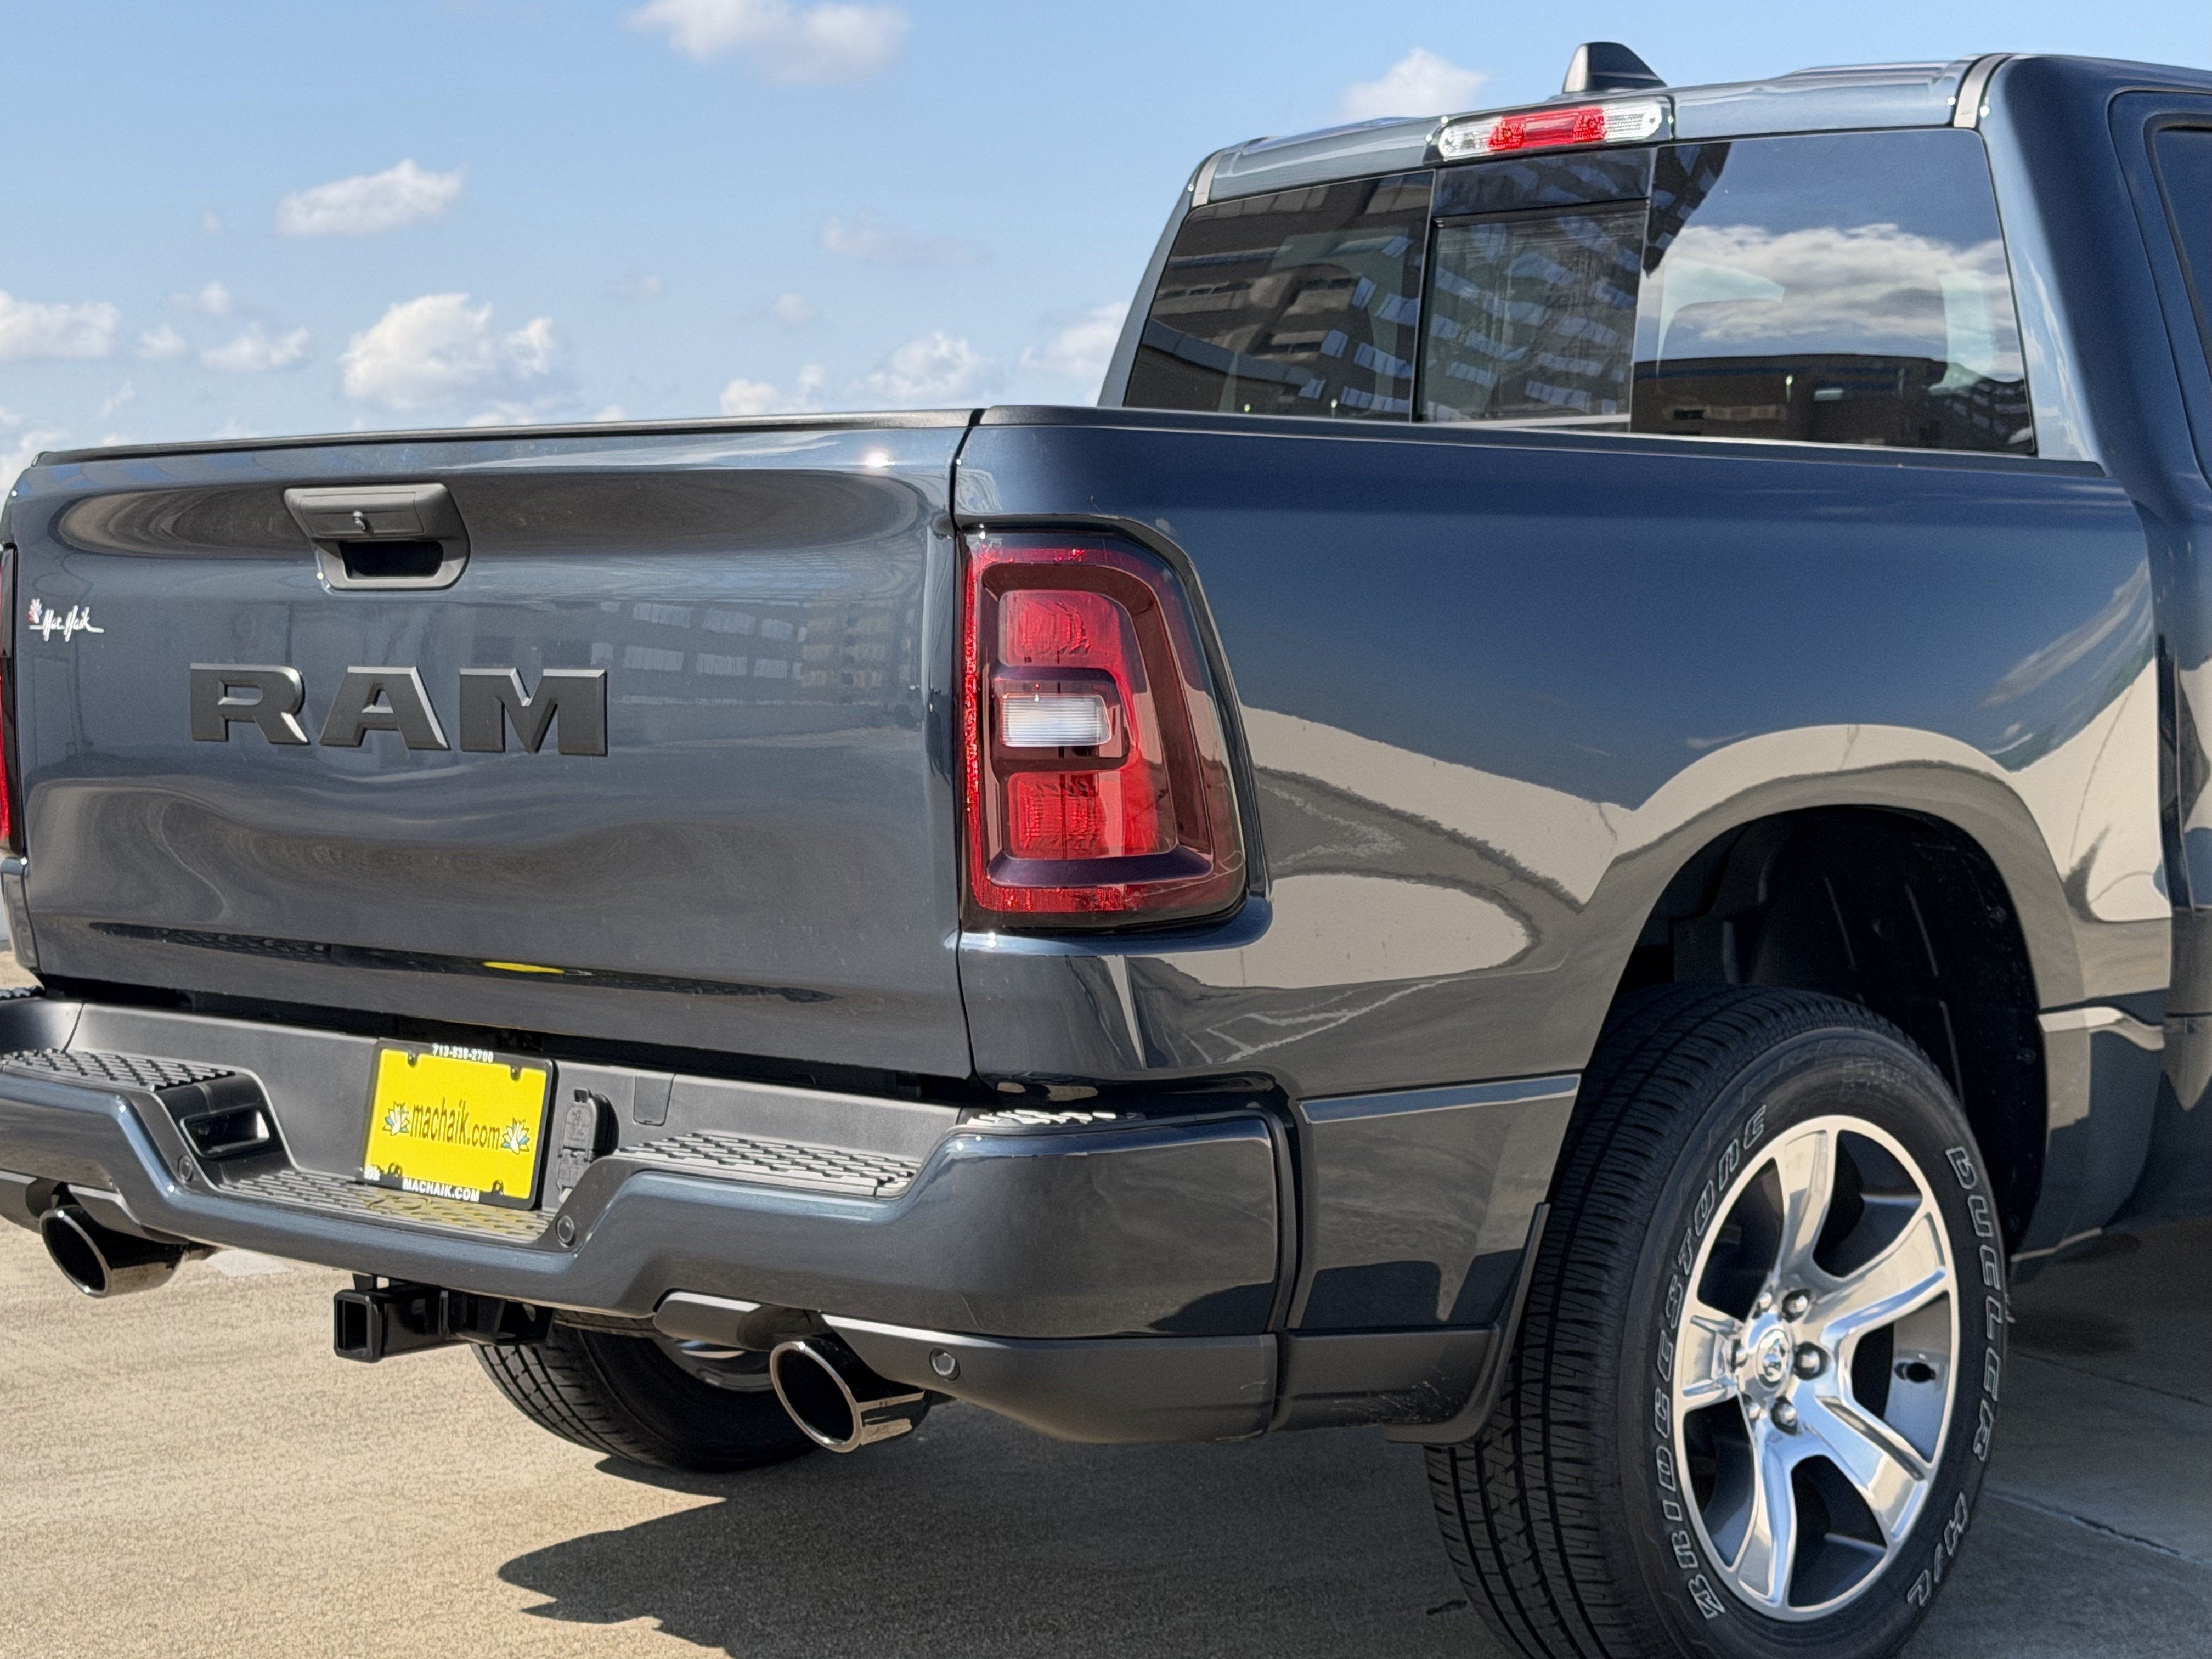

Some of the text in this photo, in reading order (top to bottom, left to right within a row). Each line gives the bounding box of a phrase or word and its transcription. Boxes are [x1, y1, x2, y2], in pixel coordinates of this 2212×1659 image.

[190, 663, 608, 756] RAM
[410, 1097, 500, 1150] machaik.com
[402, 1177, 480, 1202] MACHAIK.COM
[1945, 1146, 2002, 1462] DUELER
[1655, 1104, 1767, 1620] BRIDGESTONE
